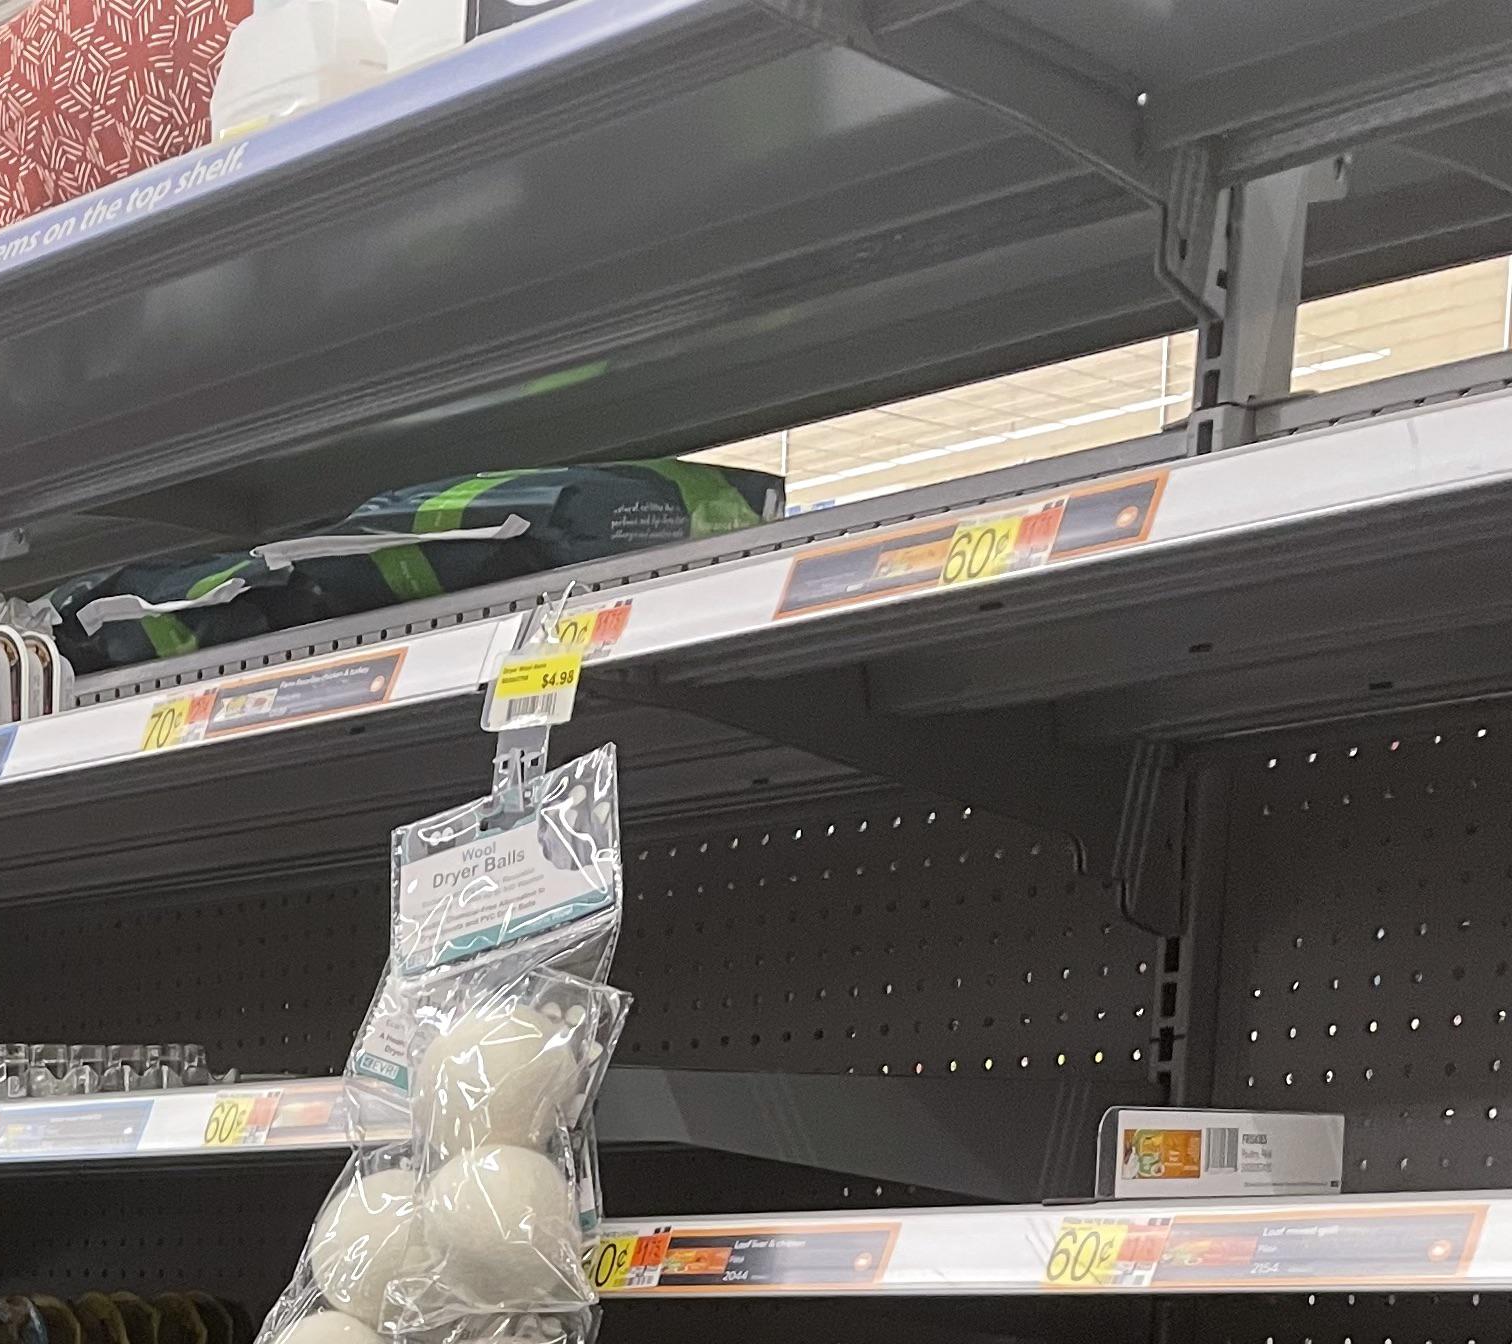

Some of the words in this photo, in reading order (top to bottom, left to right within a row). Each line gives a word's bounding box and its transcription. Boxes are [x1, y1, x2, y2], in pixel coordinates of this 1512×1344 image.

[43, 215, 75, 245] on
[78, 194, 122, 238] the
[124, 177, 172, 224] top
[172, 142, 245, 194] shelf.
[942, 528, 1010, 583] 60¢
[541, 669, 575, 689] $4.98
[144, 708, 183, 750] 70¢
[432, 864, 479, 889] Dryer
[484, 849, 525, 872] Balls
[462, 842, 497, 862] Wool
[204, 1102, 248, 1143] 60¢
[734, 1239, 752, 1250] Loaf
[1046, 1228, 1114, 1281] 60¢
[722, 1270, 749, 1282] 2044
